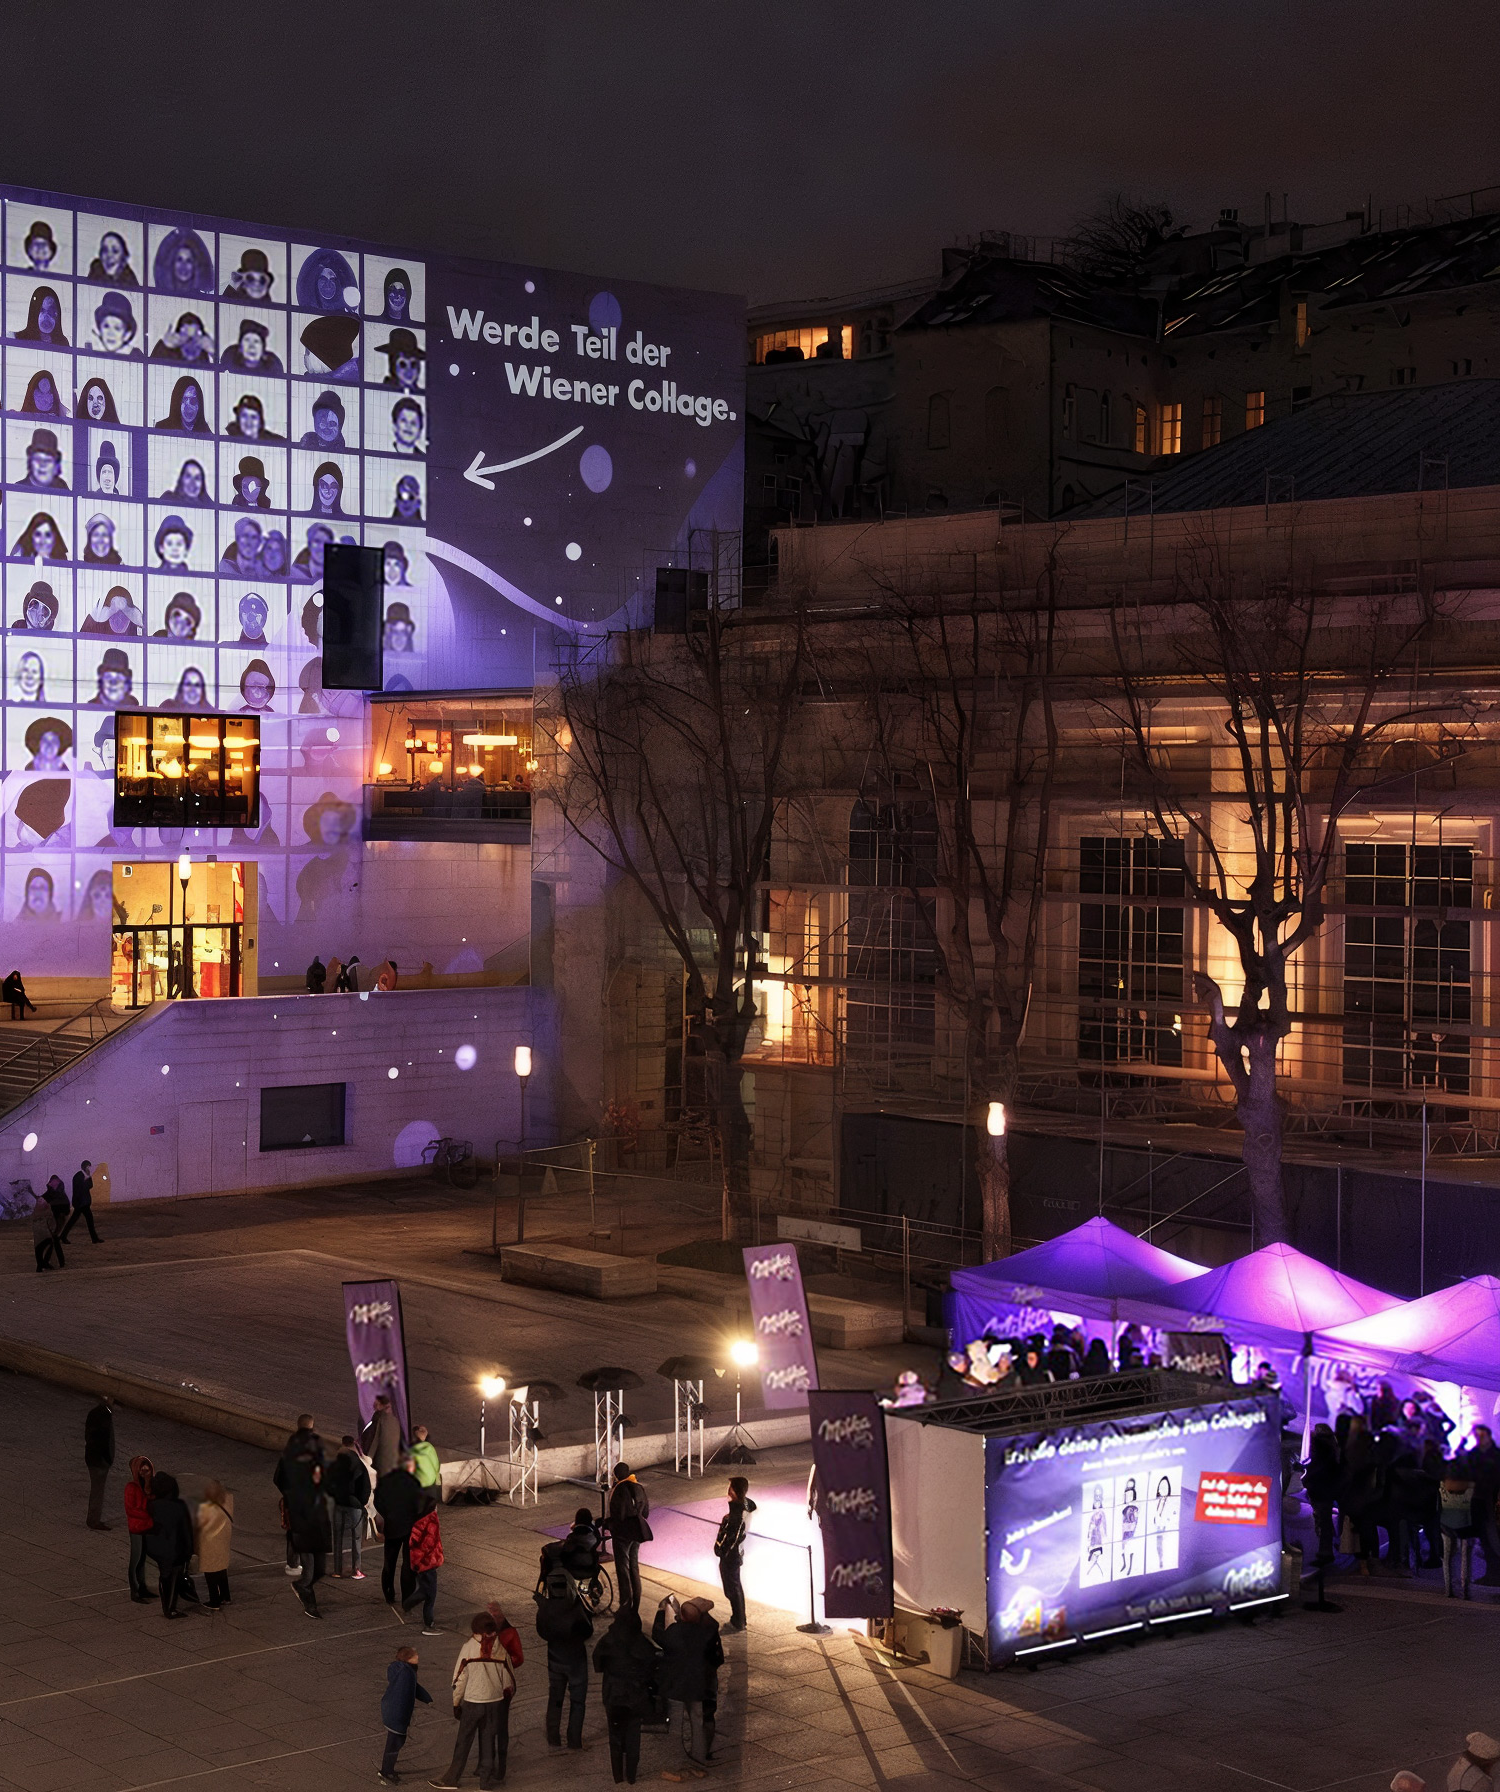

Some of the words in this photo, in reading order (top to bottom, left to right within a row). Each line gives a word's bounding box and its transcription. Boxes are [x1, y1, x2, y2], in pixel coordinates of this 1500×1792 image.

[446, 305, 560, 353] Werde
[571, 324, 617, 361] Teil
[626, 331, 671, 368] der
[504, 362, 620, 407] Wiener
[628, 379, 737, 427] Collage.
